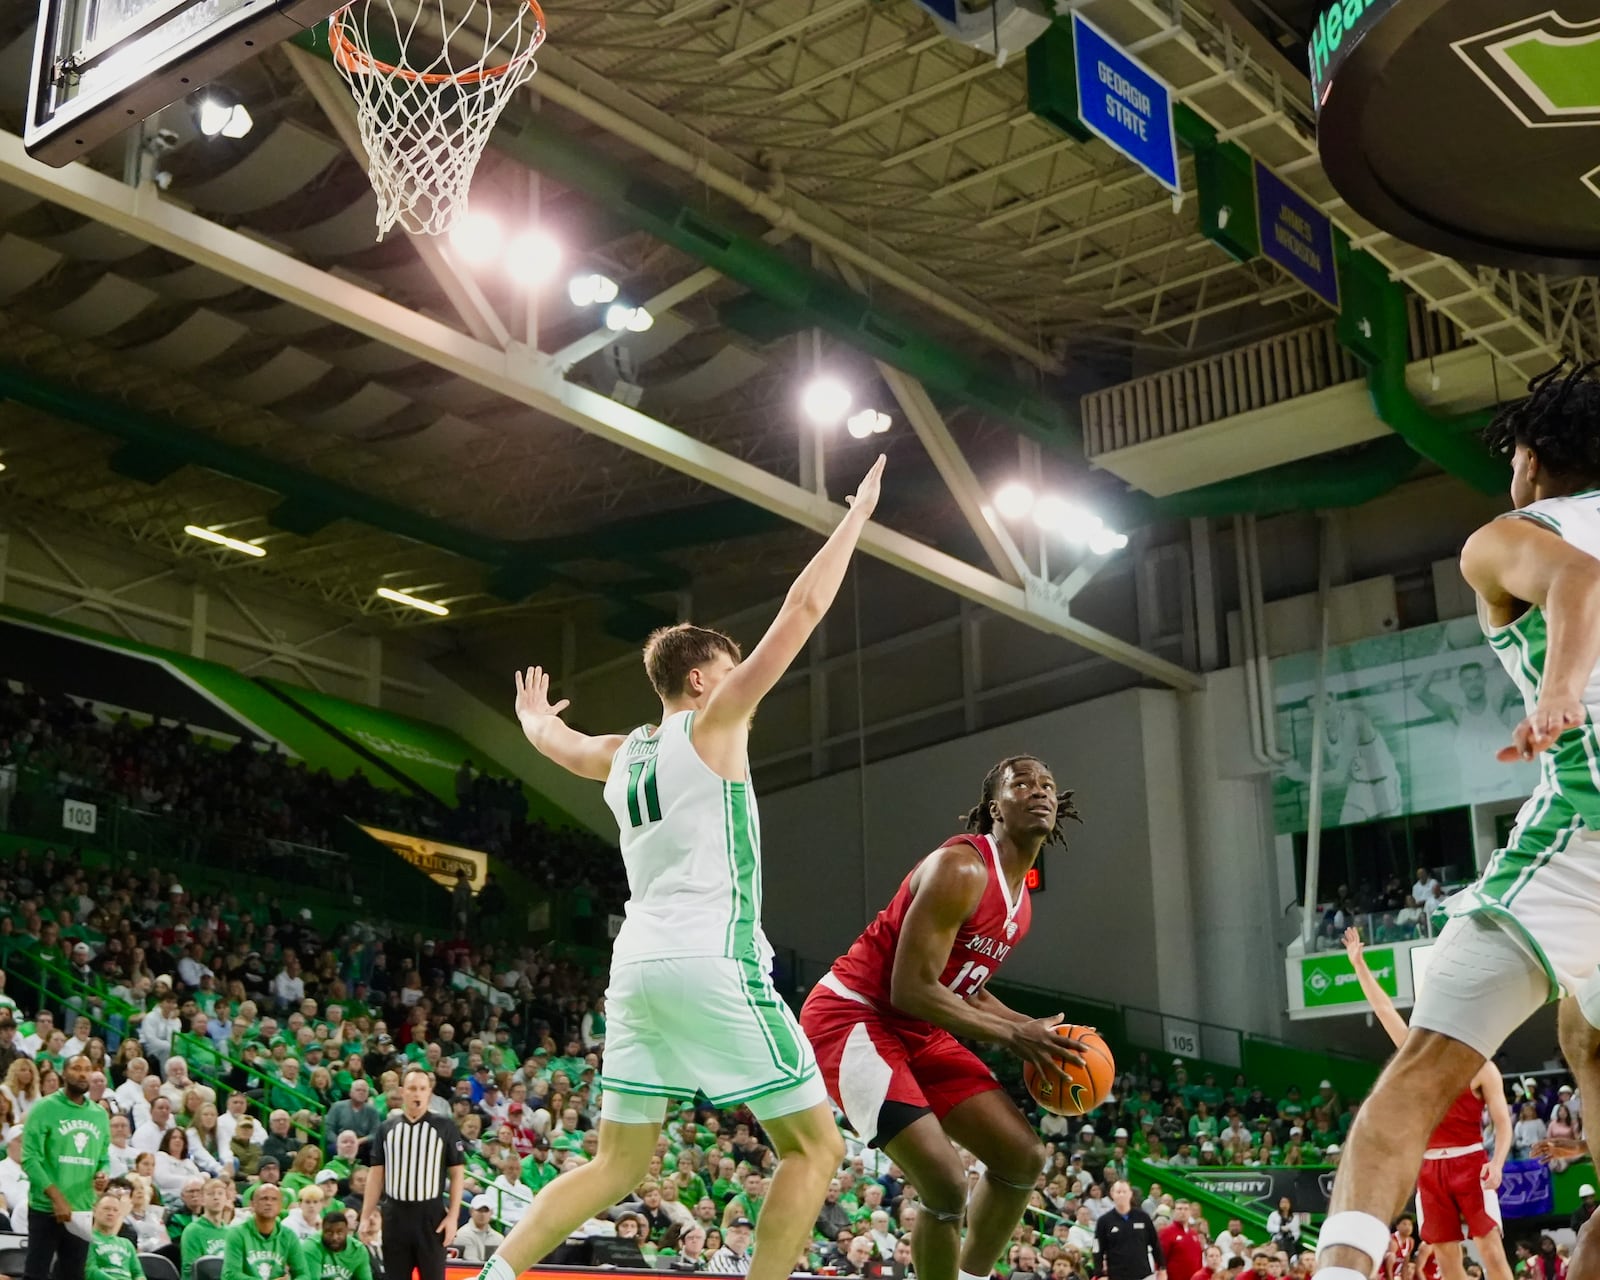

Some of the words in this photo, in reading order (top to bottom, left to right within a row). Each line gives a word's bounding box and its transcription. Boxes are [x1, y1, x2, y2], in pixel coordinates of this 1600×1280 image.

[1312, 0, 1377, 83] Hea
[1097, 59, 1151, 119] GEORGIA
[1105, 93, 1149, 142] STATE
[626, 754, 663, 828] 11
[69, 806, 93, 827] 103
[1172, 1036, 1194, 1052] 105
[58, 1119, 101, 1140] MARSHALL
